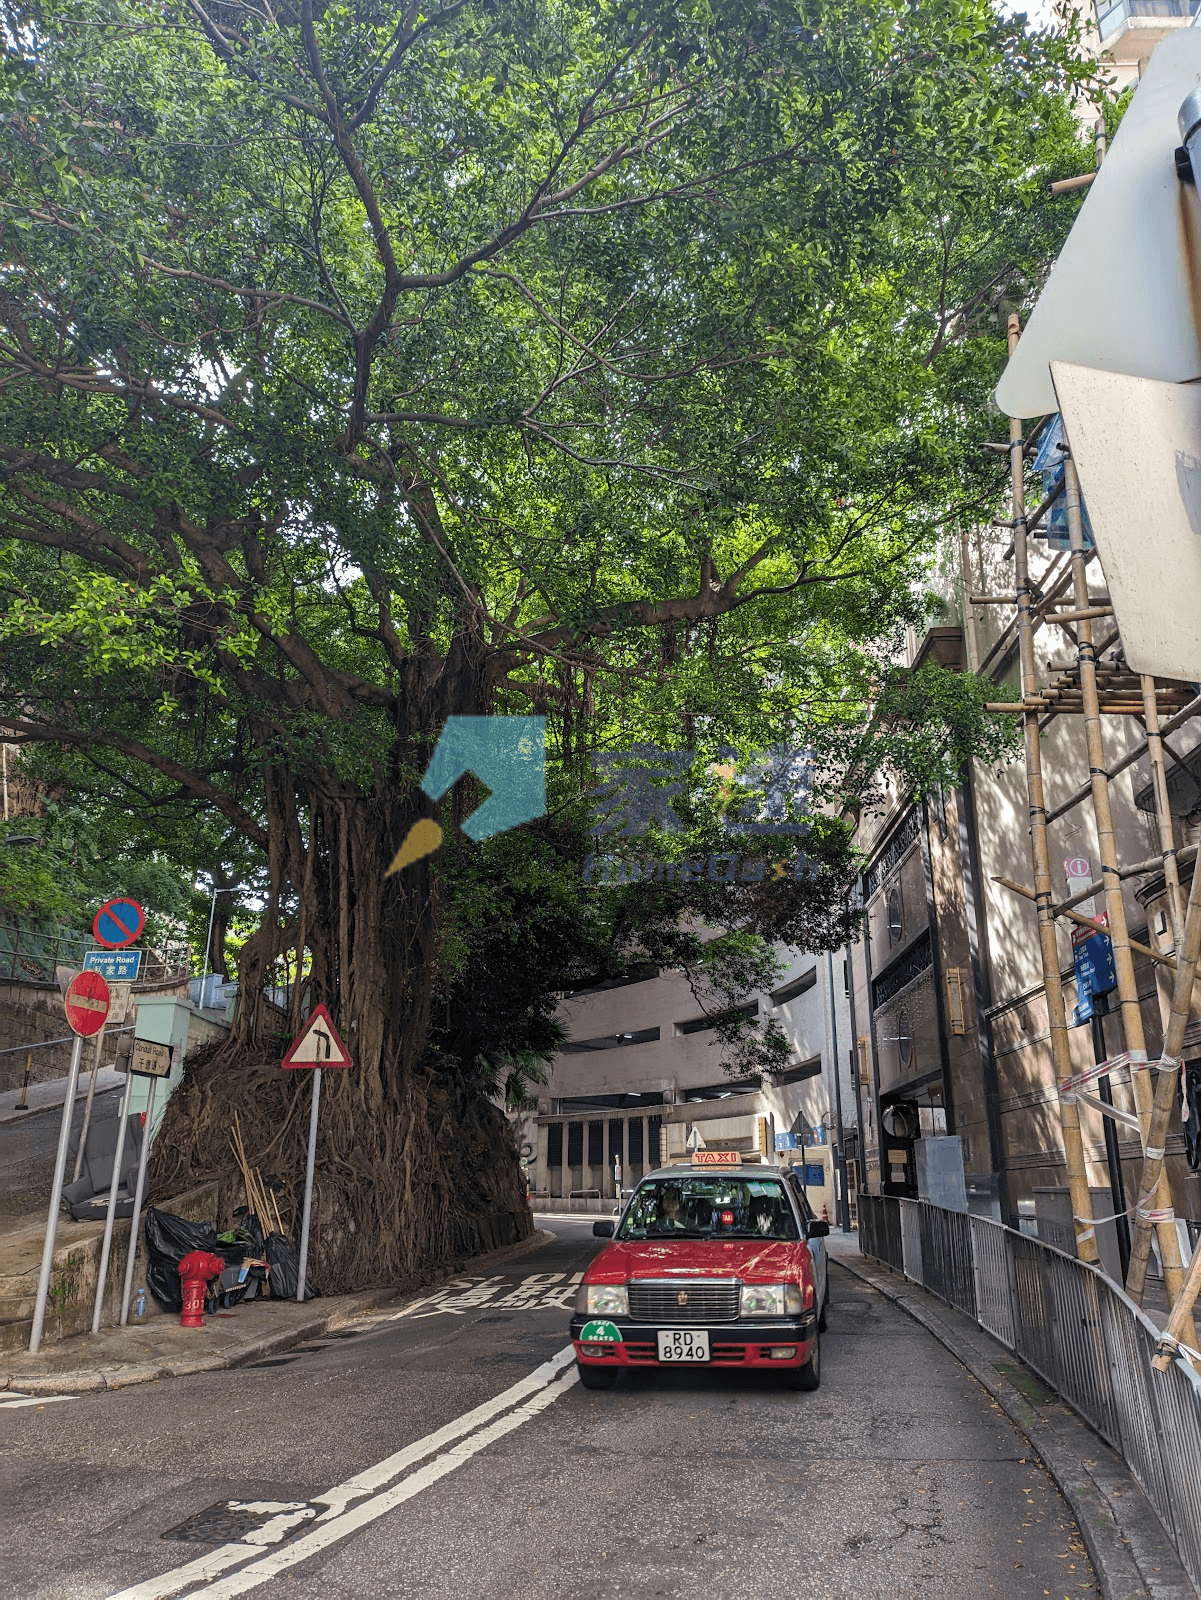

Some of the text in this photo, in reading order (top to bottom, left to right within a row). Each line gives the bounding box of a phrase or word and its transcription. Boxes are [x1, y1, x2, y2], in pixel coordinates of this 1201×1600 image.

[95, 965, 127, 976] 私家路
[695, 1153, 737, 1163] TAXI
[721, 1214, 733, 1222] TAXI
[596, 1326, 605, 1335] 4
[673, 1332, 693, 1346] RD
[663, 1345, 705, 1359] 8940
